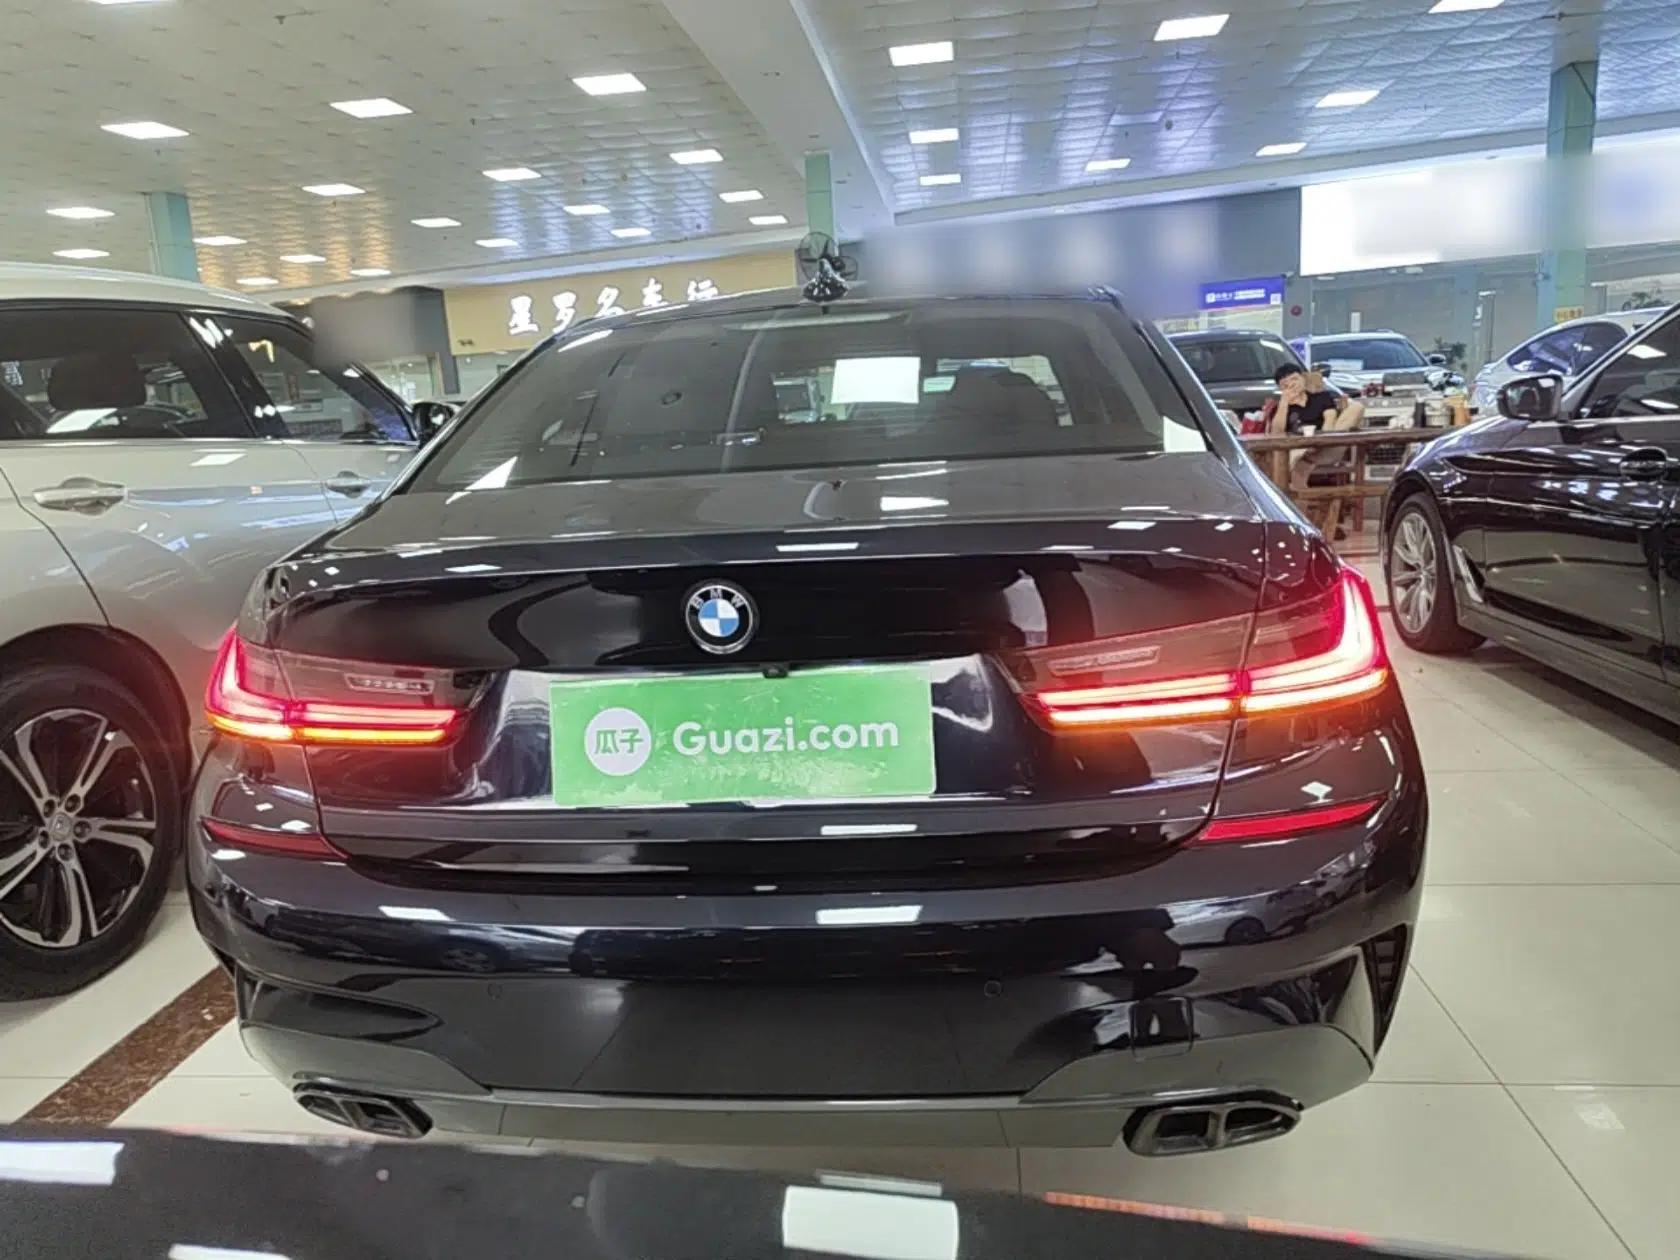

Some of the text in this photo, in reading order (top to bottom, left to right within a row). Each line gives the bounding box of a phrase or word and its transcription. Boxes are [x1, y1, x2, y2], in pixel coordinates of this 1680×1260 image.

[689, 587, 747, 609] BMW
[594, 716, 899, 757] 瓜子 Guazi.com
